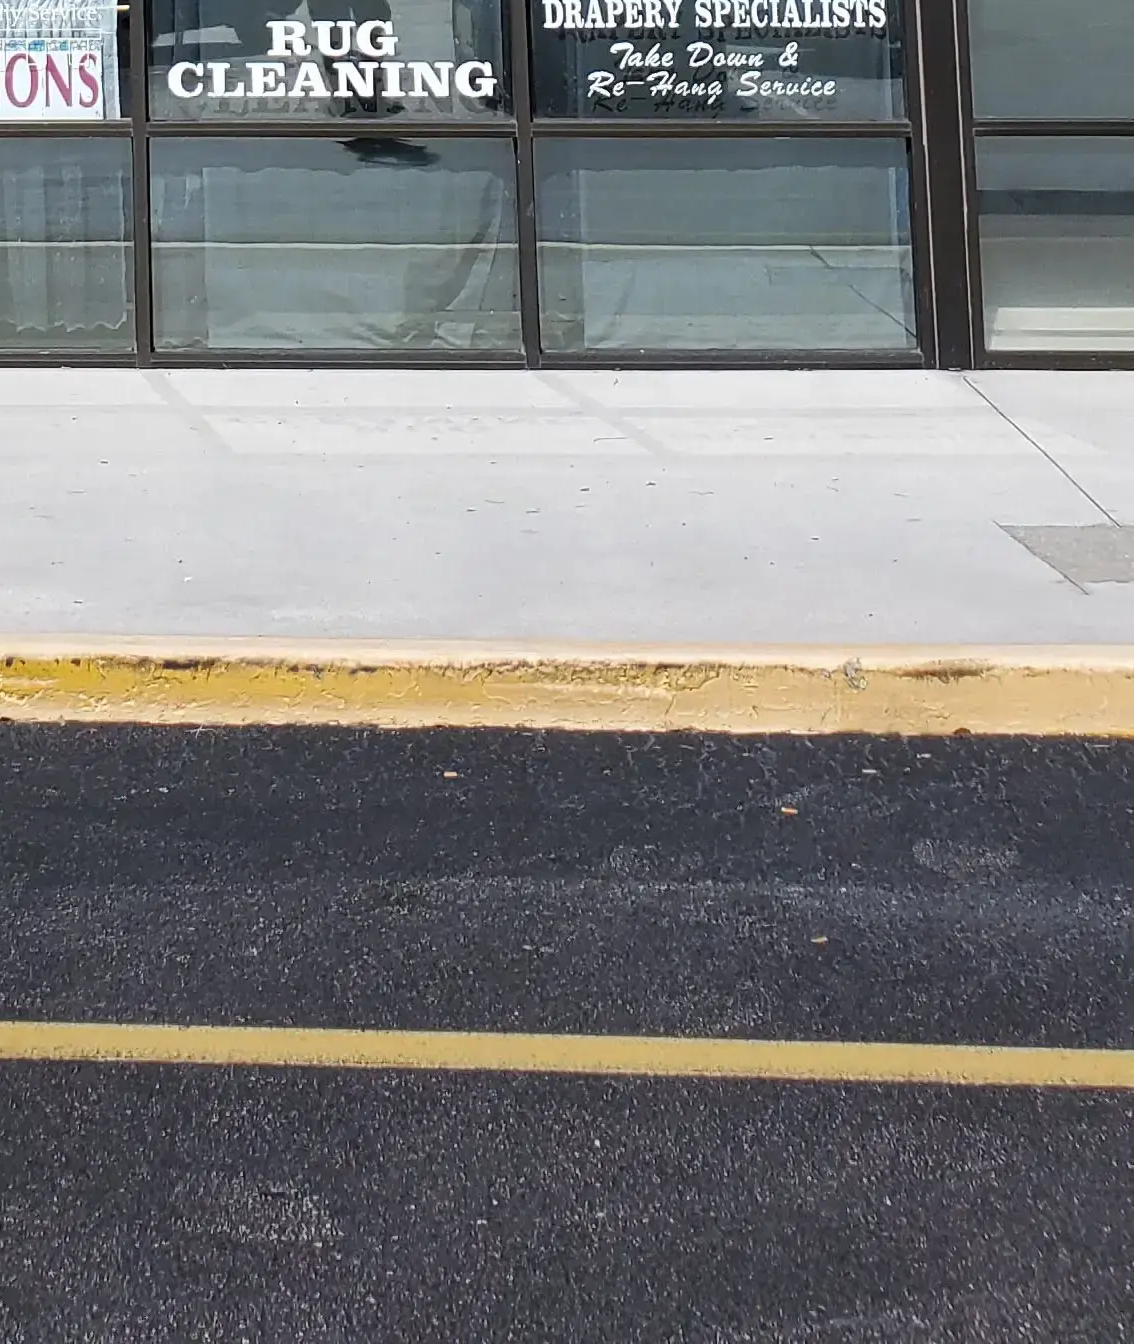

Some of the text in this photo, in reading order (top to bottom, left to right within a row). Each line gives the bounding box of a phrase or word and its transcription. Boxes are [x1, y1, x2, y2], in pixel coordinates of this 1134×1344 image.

[265, 19, 398, 57] RUG
[609, 42, 799, 70] Take Down &
[167, 61, 497, 98] CLEANING
[736, 70, 836, 98] Service
